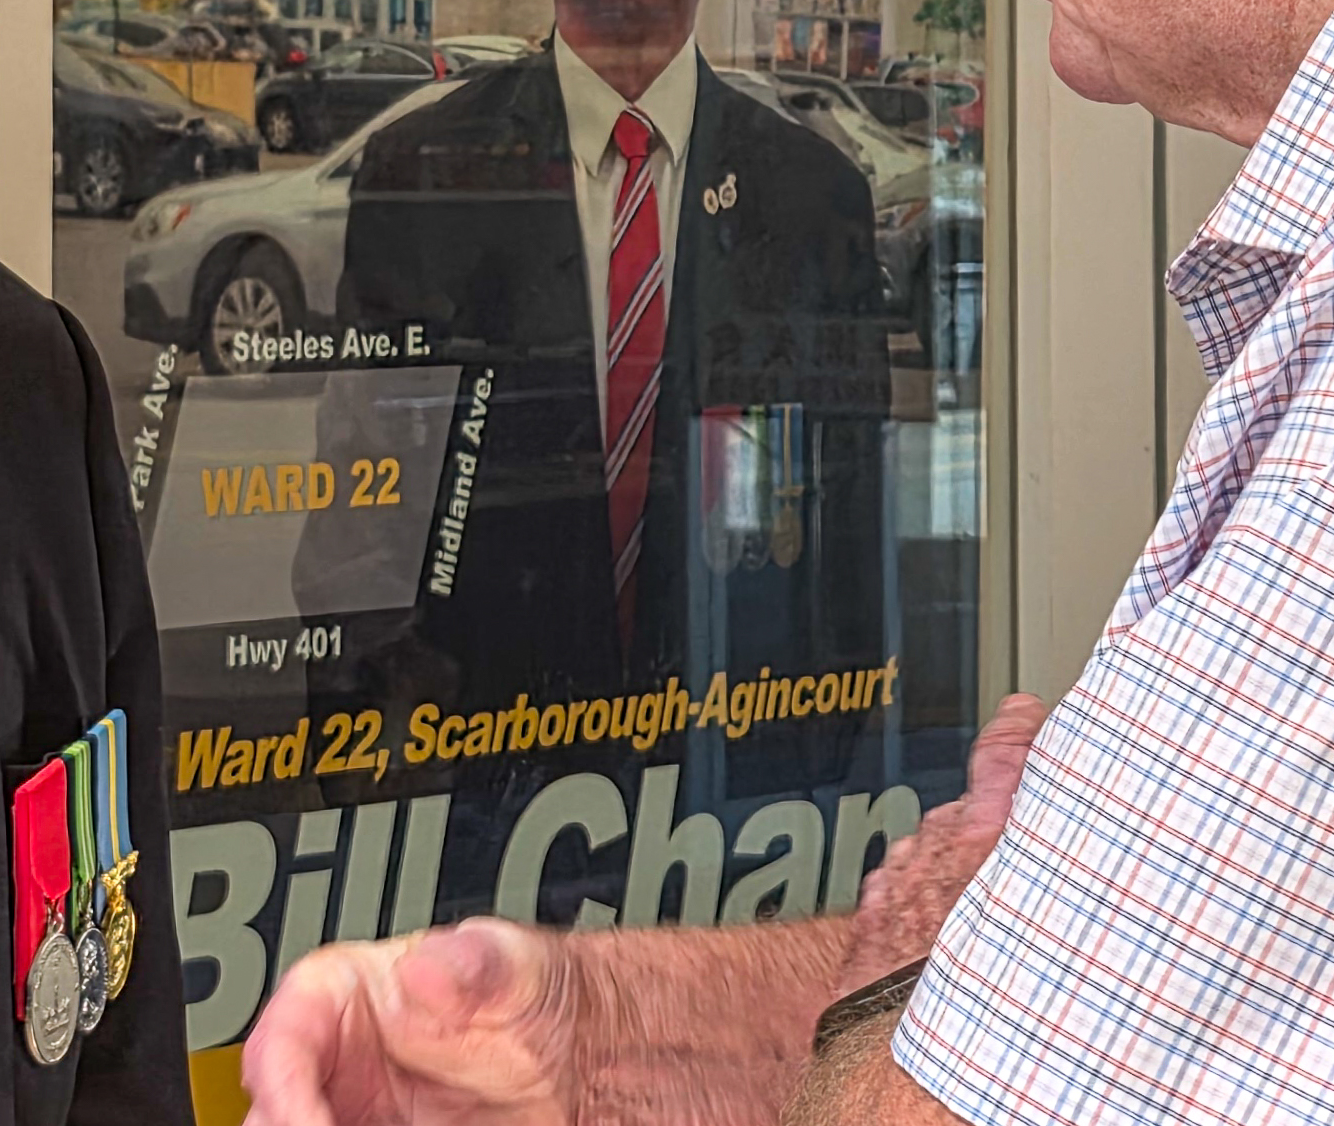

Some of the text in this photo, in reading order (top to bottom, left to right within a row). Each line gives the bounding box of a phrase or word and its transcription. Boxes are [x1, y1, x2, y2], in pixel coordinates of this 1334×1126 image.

[143, 343, 179, 420] Ave.
[232, 325, 432, 363] Steeles Ave. E.
[201, 457, 402, 518] WARD 22
[428, 367, 495, 598] Midland Ave.
[226, 625, 344, 672] Hwy 401
[176, 658, 899, 793] Ward 22, Scarborough-Agincourt
[169, 793, 452, 1050] Bill
